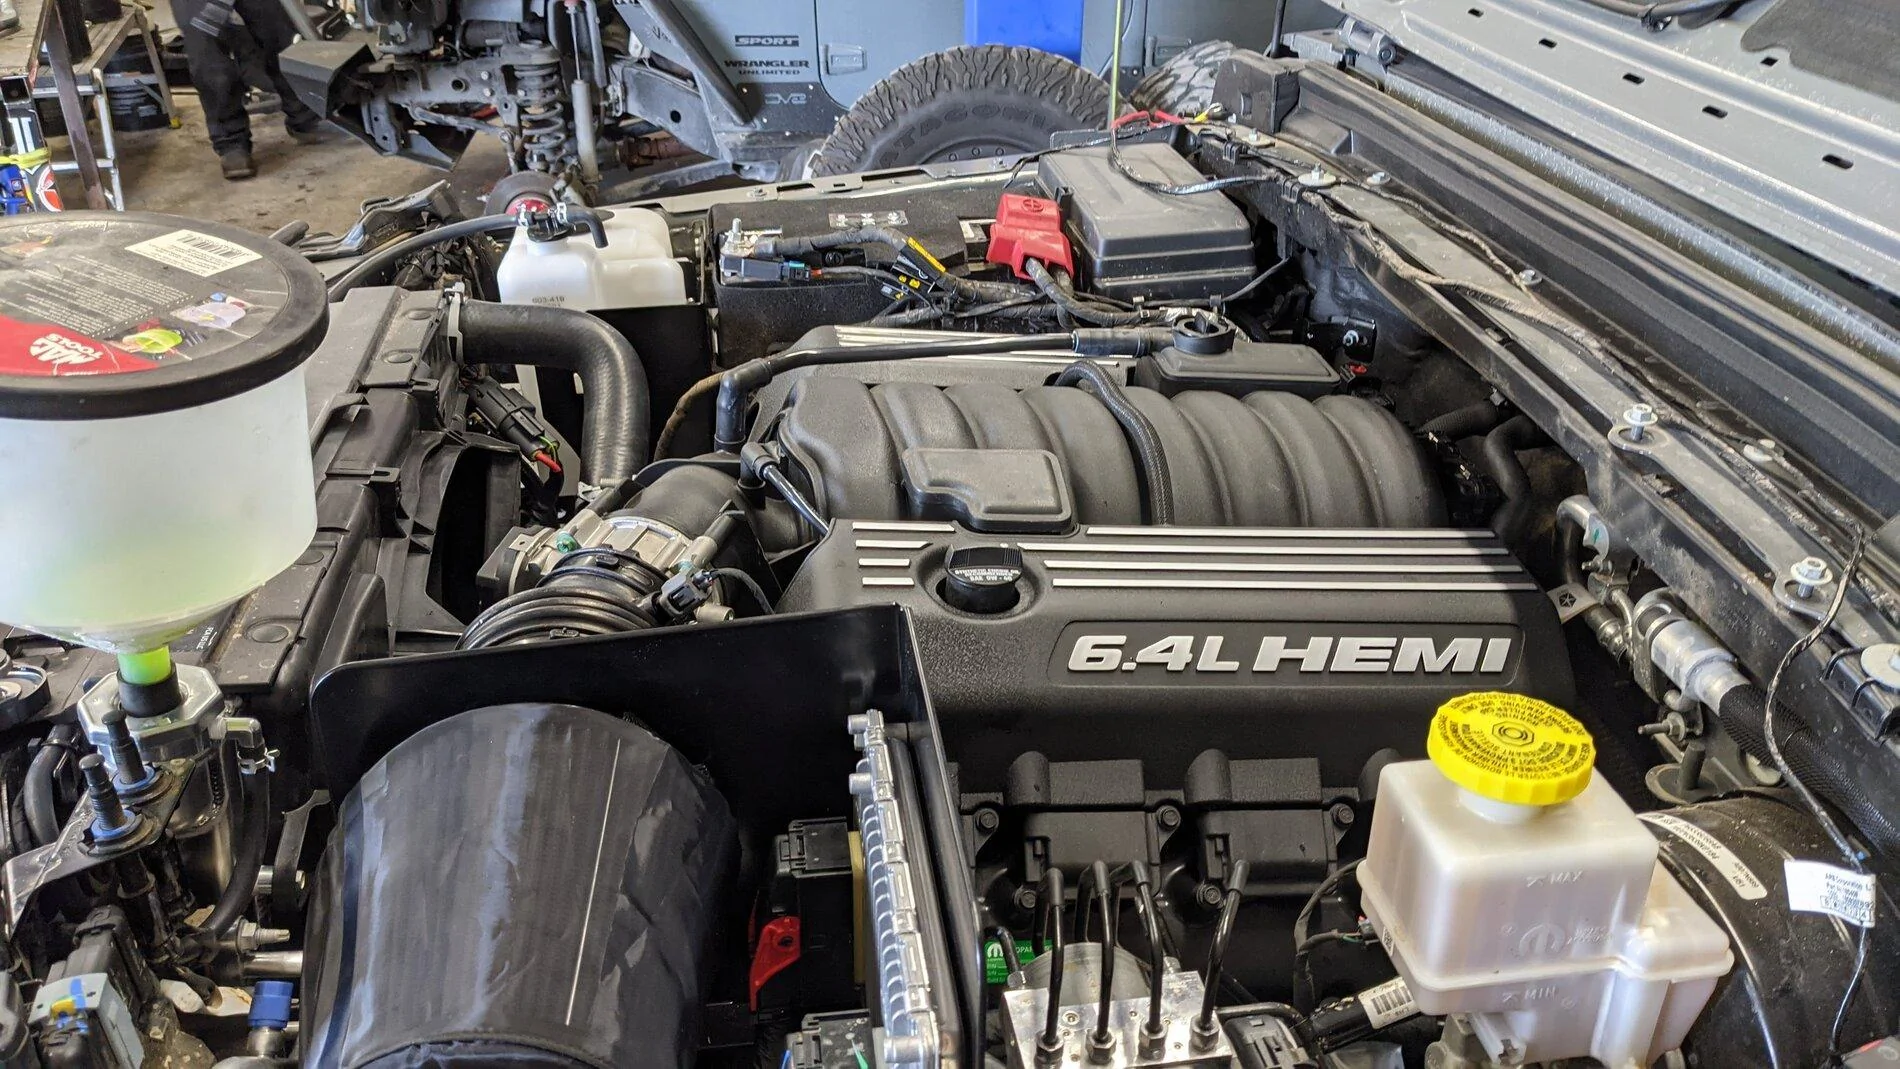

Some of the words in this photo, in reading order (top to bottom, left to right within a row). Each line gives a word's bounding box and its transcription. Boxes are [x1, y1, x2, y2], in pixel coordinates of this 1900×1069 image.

[736, 37, 797, 46] SPORT
[724, 60, 810, 68] WRANGLER
[30, 337, 96, 365] MAC
[46, 333, 104, 359] TOOLS
[1067, 635, 1239, 672] 6.4L
[1252, 636, 1512, 673] HEMI
[1550, 869, 1584, 885] MAX
[1524, 985, 1557, 1001] MIN
